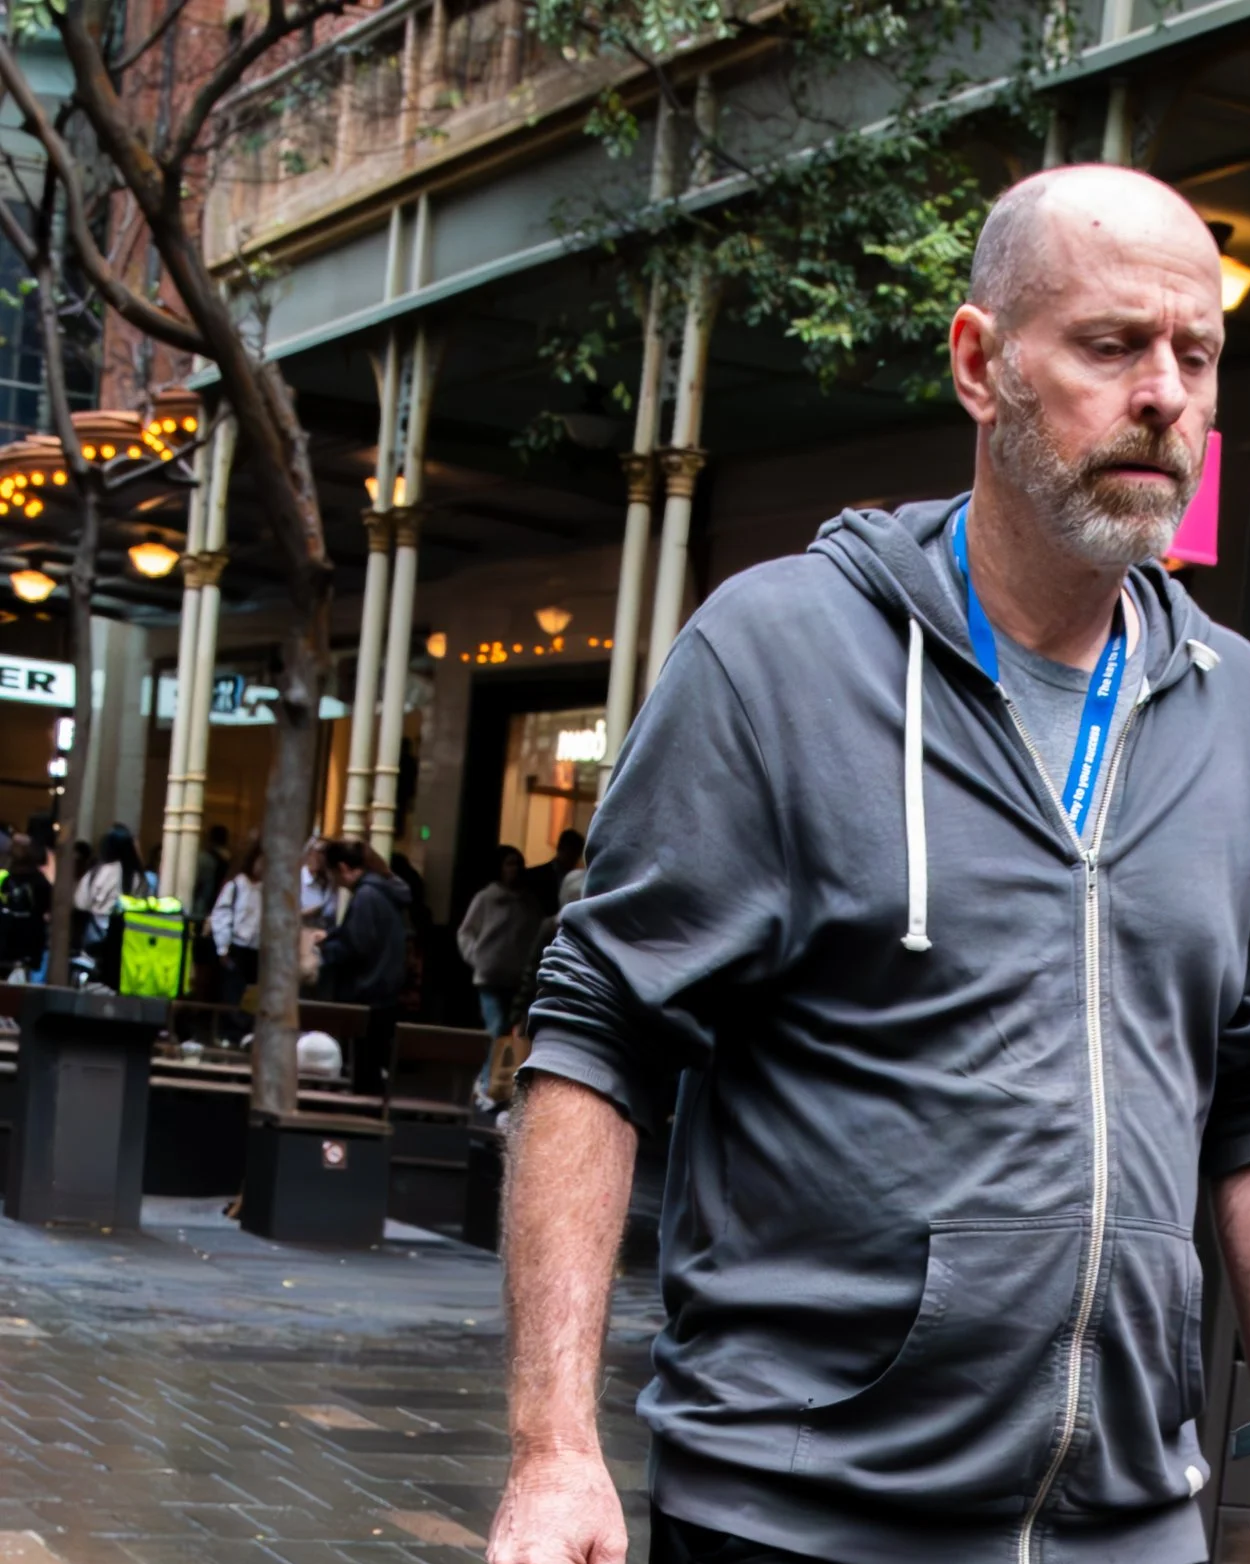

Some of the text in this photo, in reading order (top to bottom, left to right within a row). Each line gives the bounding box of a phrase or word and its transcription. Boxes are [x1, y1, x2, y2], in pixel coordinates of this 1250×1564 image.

[1103, 660, 1118, 680] key
[1096, 675, 1112, 697] The
[1085, 724, 1101, 764] success
[1078, 762, 1092, 789] your
[1073, 787, 1086, 801] to
